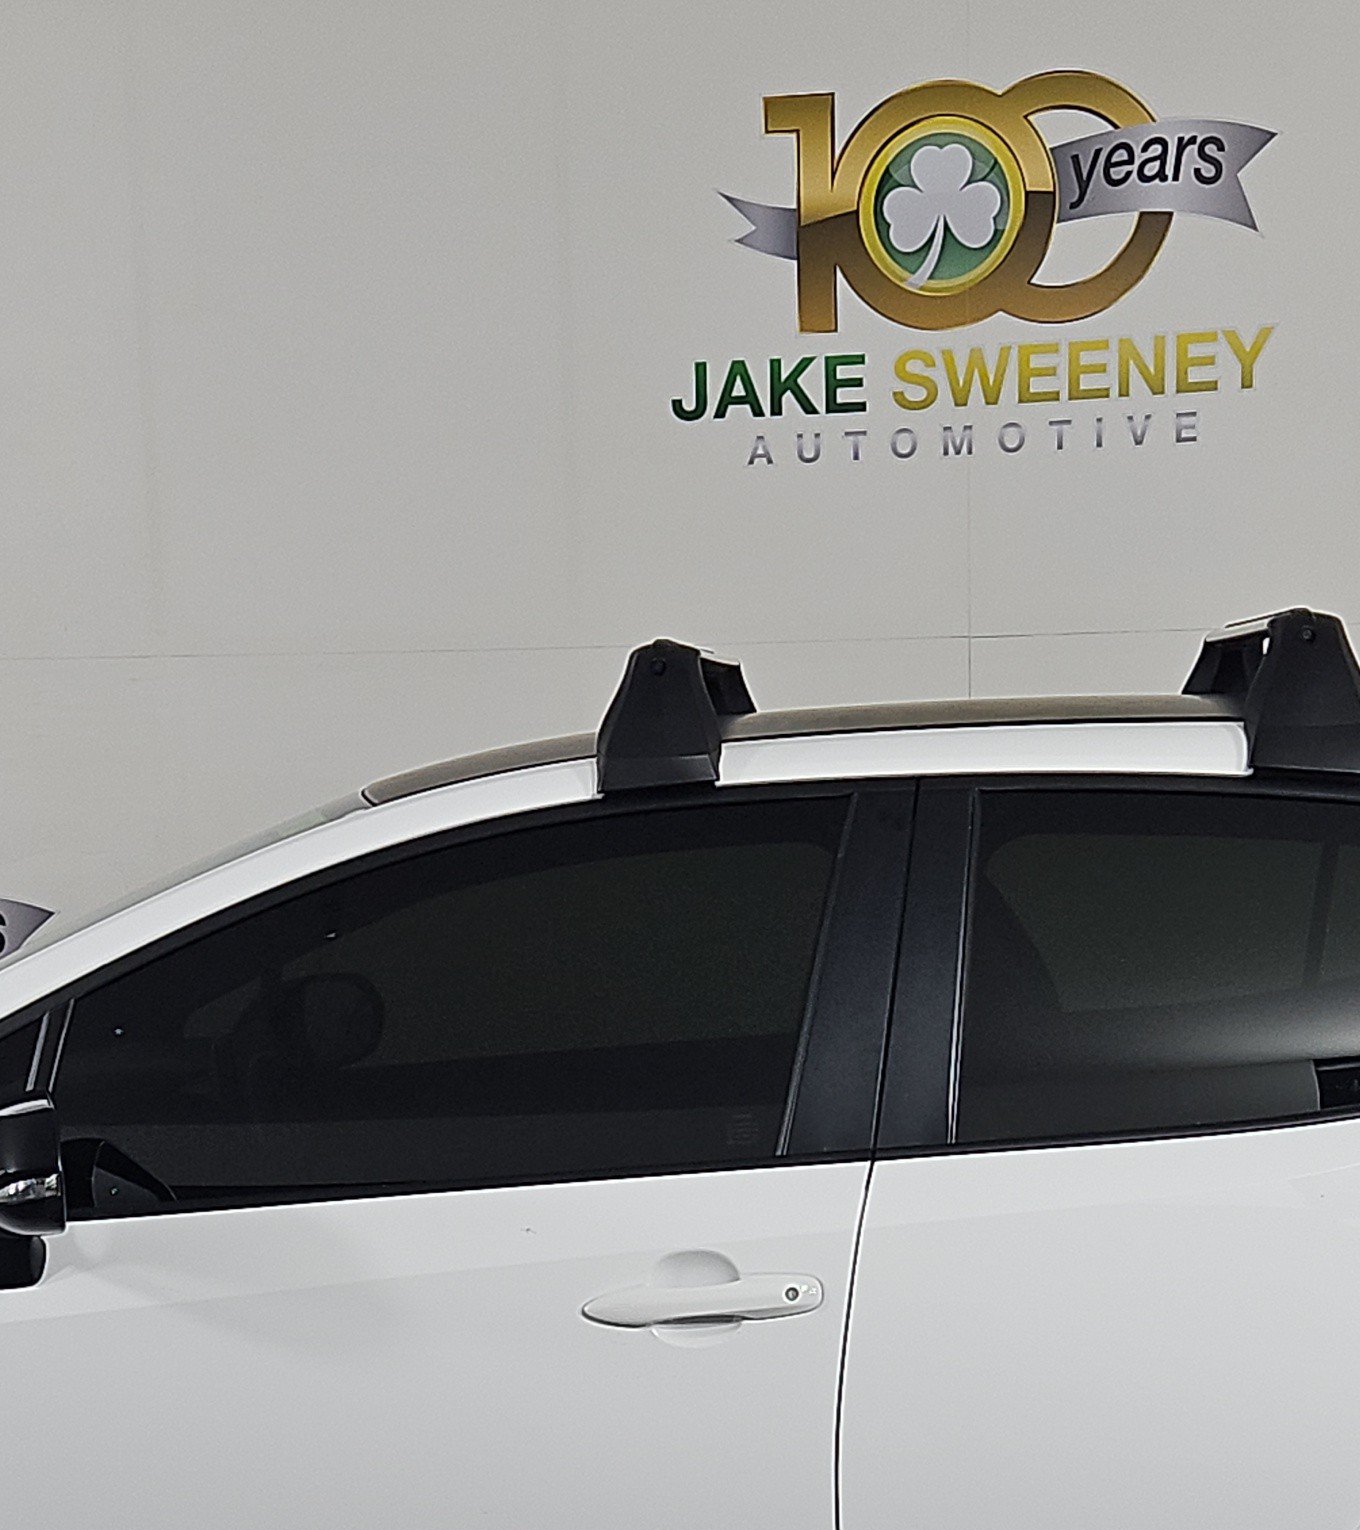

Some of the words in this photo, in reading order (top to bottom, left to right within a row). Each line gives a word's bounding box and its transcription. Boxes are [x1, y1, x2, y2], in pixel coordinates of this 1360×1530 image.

[762, 69, 1174, 334] 100
[1067, 133, 1227, 209] years
[670, 353, 867, 421] JAKE
[891, 325, 1277, 411] SWEENEY
[747, 411, 1199, 466] AUTOMOTIVE
